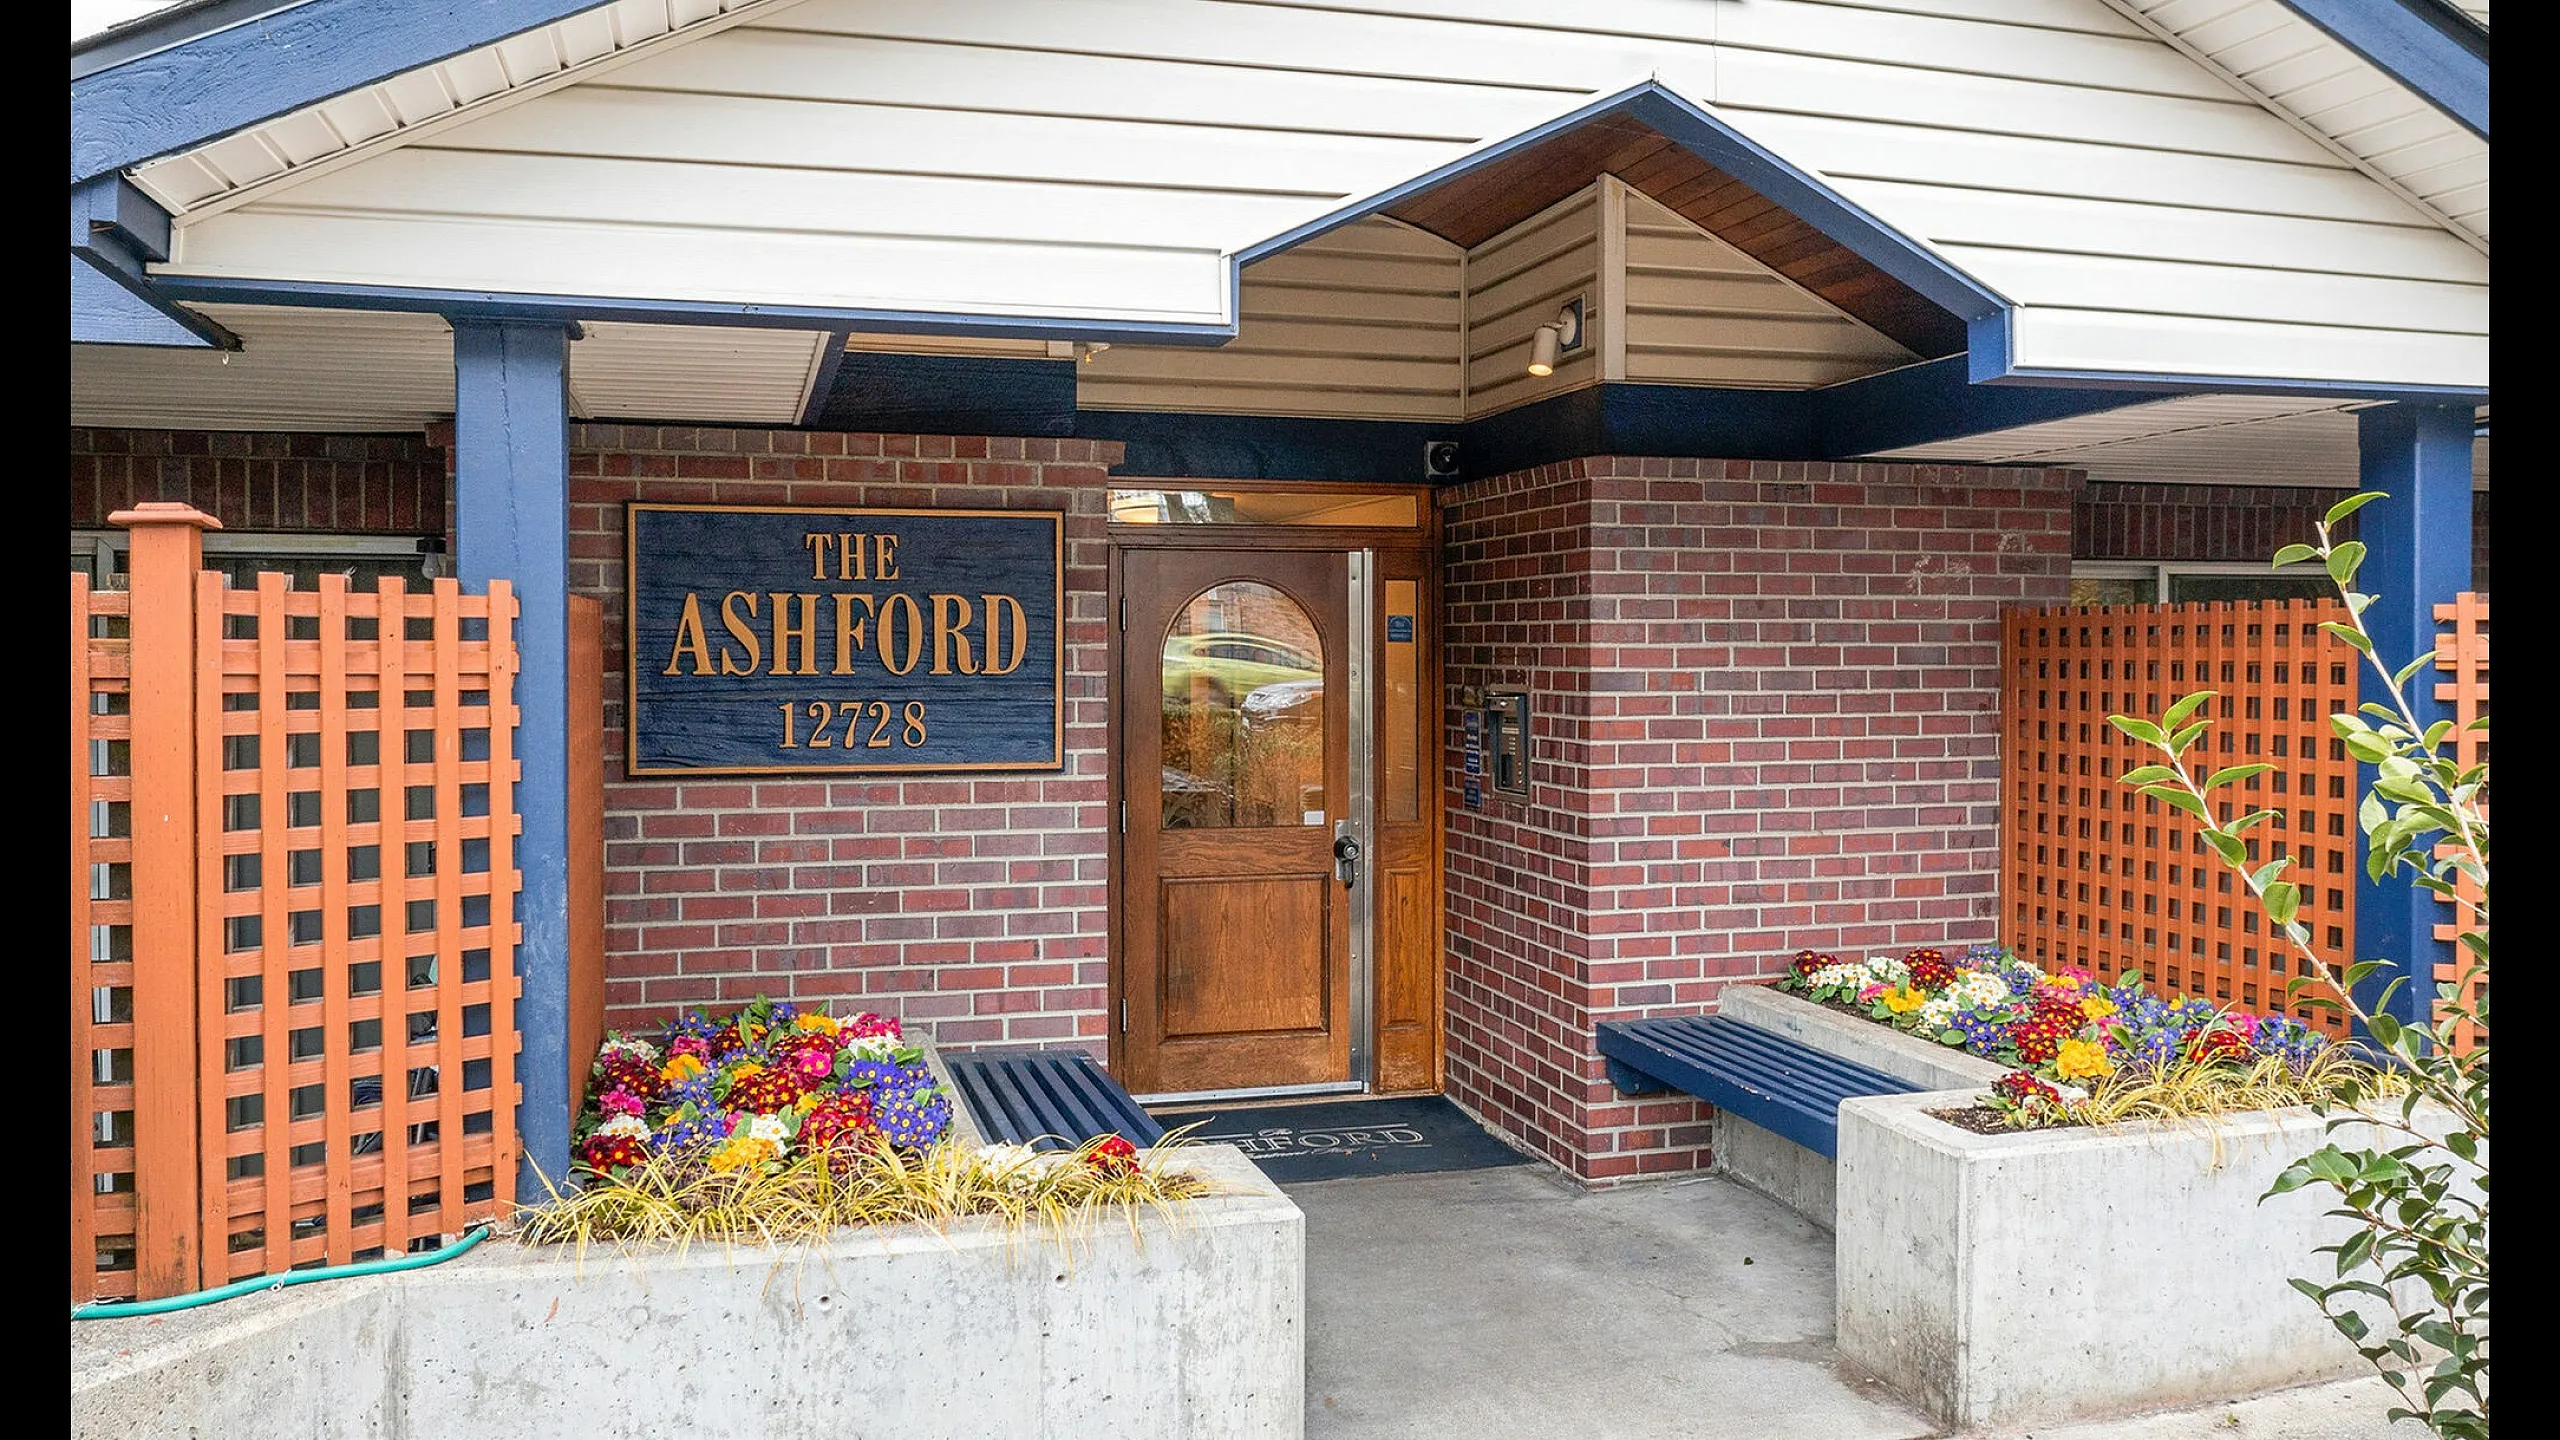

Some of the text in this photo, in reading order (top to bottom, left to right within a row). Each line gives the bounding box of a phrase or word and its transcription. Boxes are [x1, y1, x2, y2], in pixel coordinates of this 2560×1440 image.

[806, 533, 899, 580] THE
[663, 591, 1028, 676] ASHFORD
[780, 701, 926, 748] 12728
